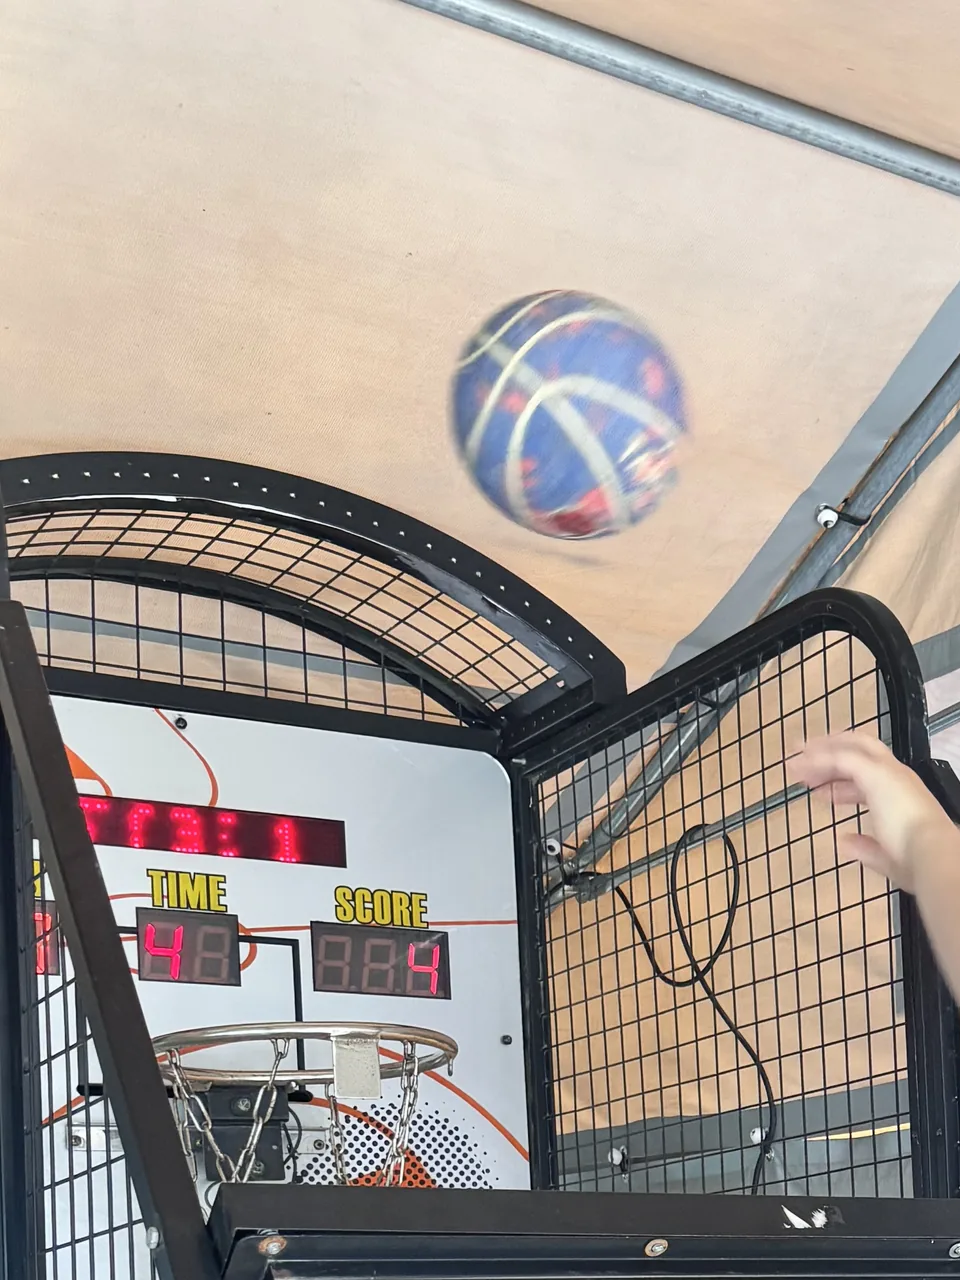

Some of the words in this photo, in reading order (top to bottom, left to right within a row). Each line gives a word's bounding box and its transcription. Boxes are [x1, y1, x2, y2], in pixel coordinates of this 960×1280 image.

[146, 868, 228, 912] TIME
[334, 885, 428, 928] SCORE
[144, 922, 184, 980] 4
[407, 942, 440, 995] 4
